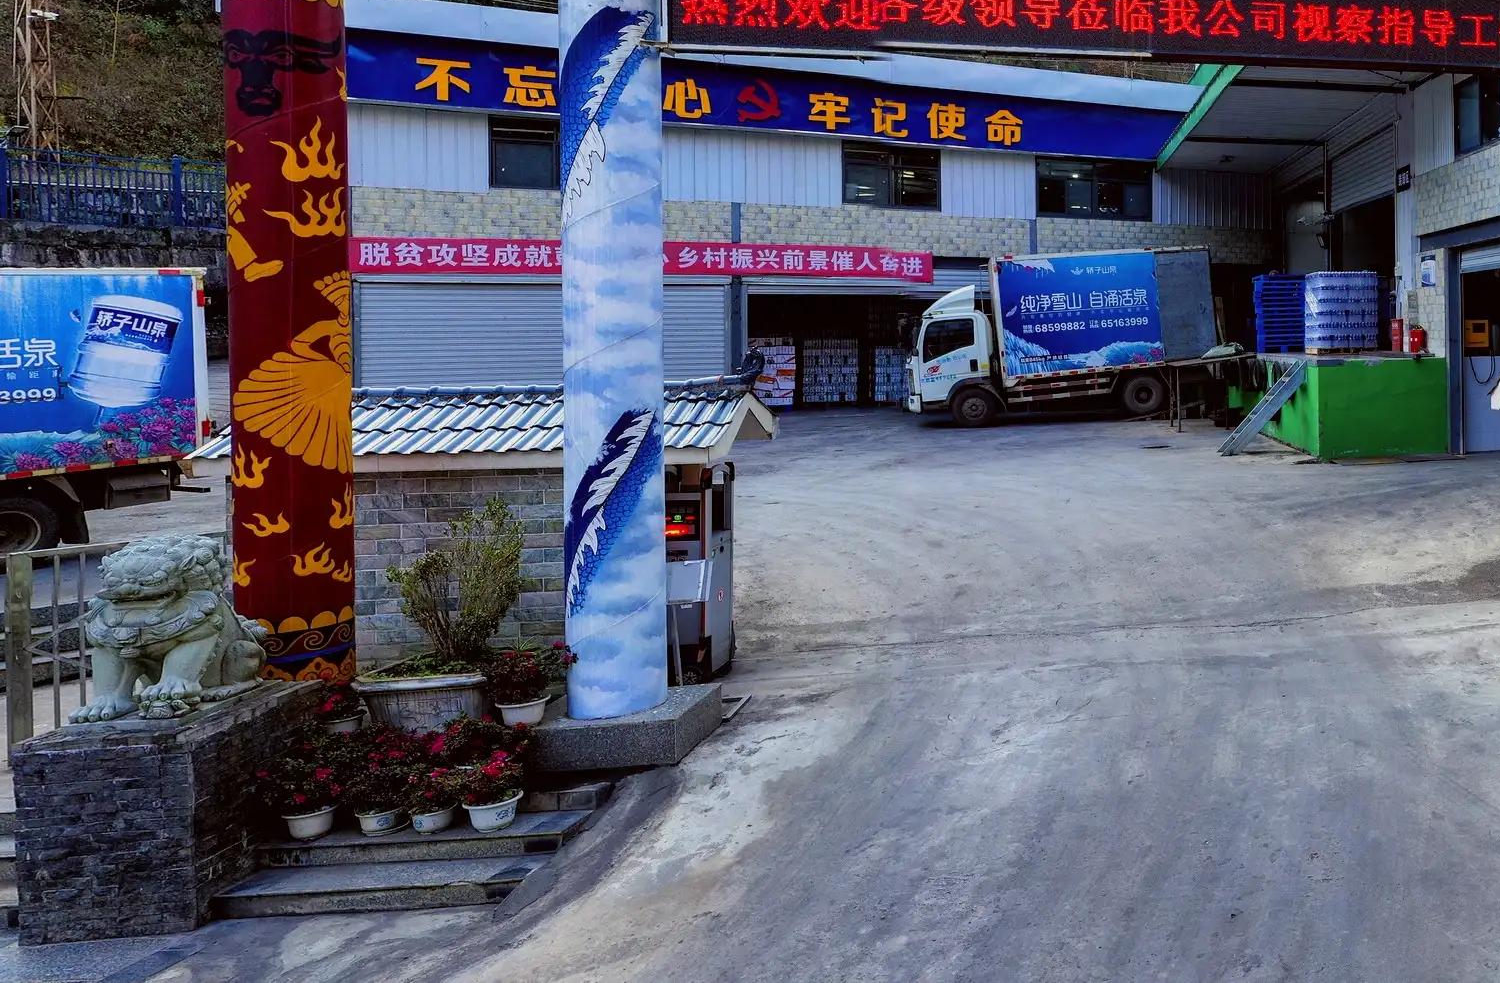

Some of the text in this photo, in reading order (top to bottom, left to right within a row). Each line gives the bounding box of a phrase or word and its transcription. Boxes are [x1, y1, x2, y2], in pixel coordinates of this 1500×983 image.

[808, 92, 1023, 146] 牢记使命
[678, 247, 923, 277] 乡村振兴前景催人奋进
[1020, 288, 1148, 312] 纯净雪山 自涌活泉
[96, 310, 168, 338] 轿子山泉
[1034, 321, 1086, 333] 68599882
[1101, 316, 1149, 328] 65163999
